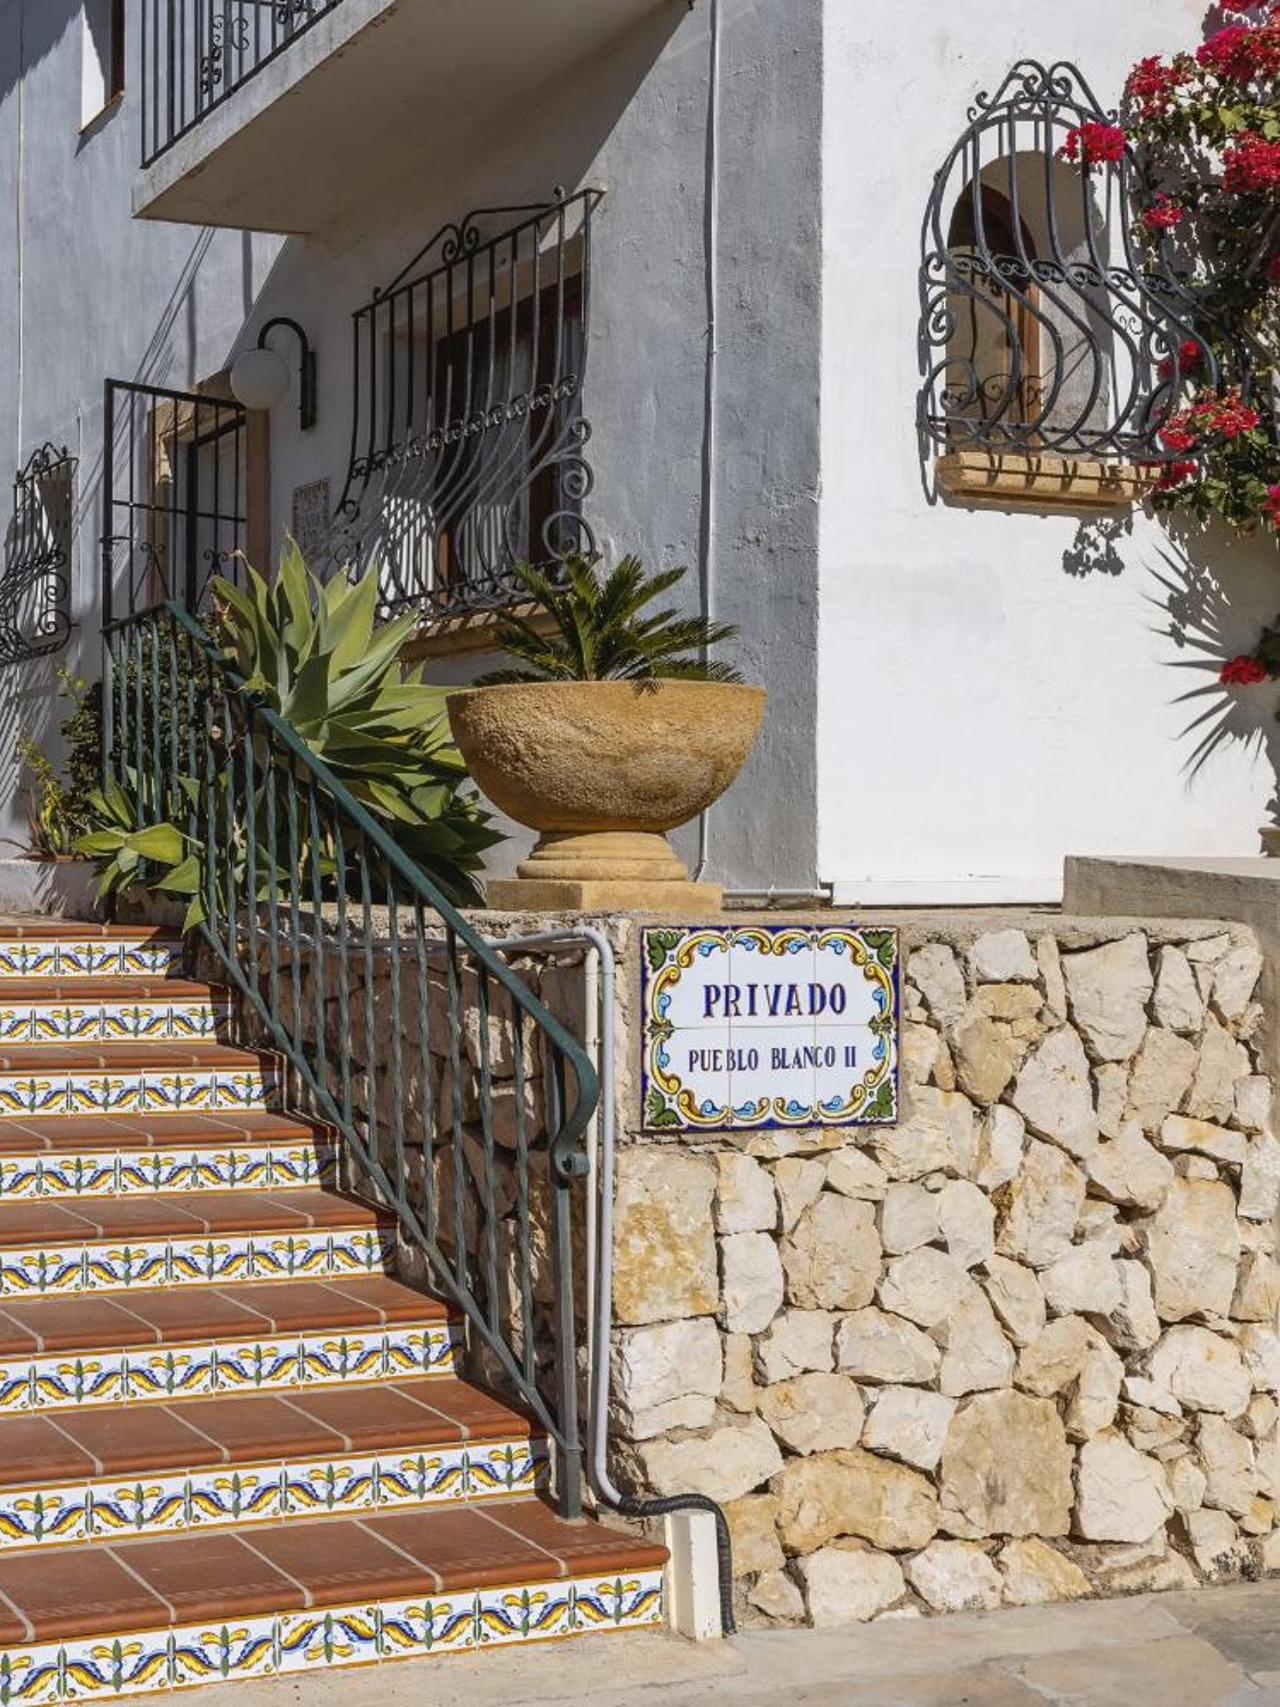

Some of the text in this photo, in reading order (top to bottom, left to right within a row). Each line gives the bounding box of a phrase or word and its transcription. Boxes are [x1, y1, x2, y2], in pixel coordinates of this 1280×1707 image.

[703, 983, 847, 1018] PRIVADO
[688, 1046, 857, 1072] PUEBLO BLANCO II
